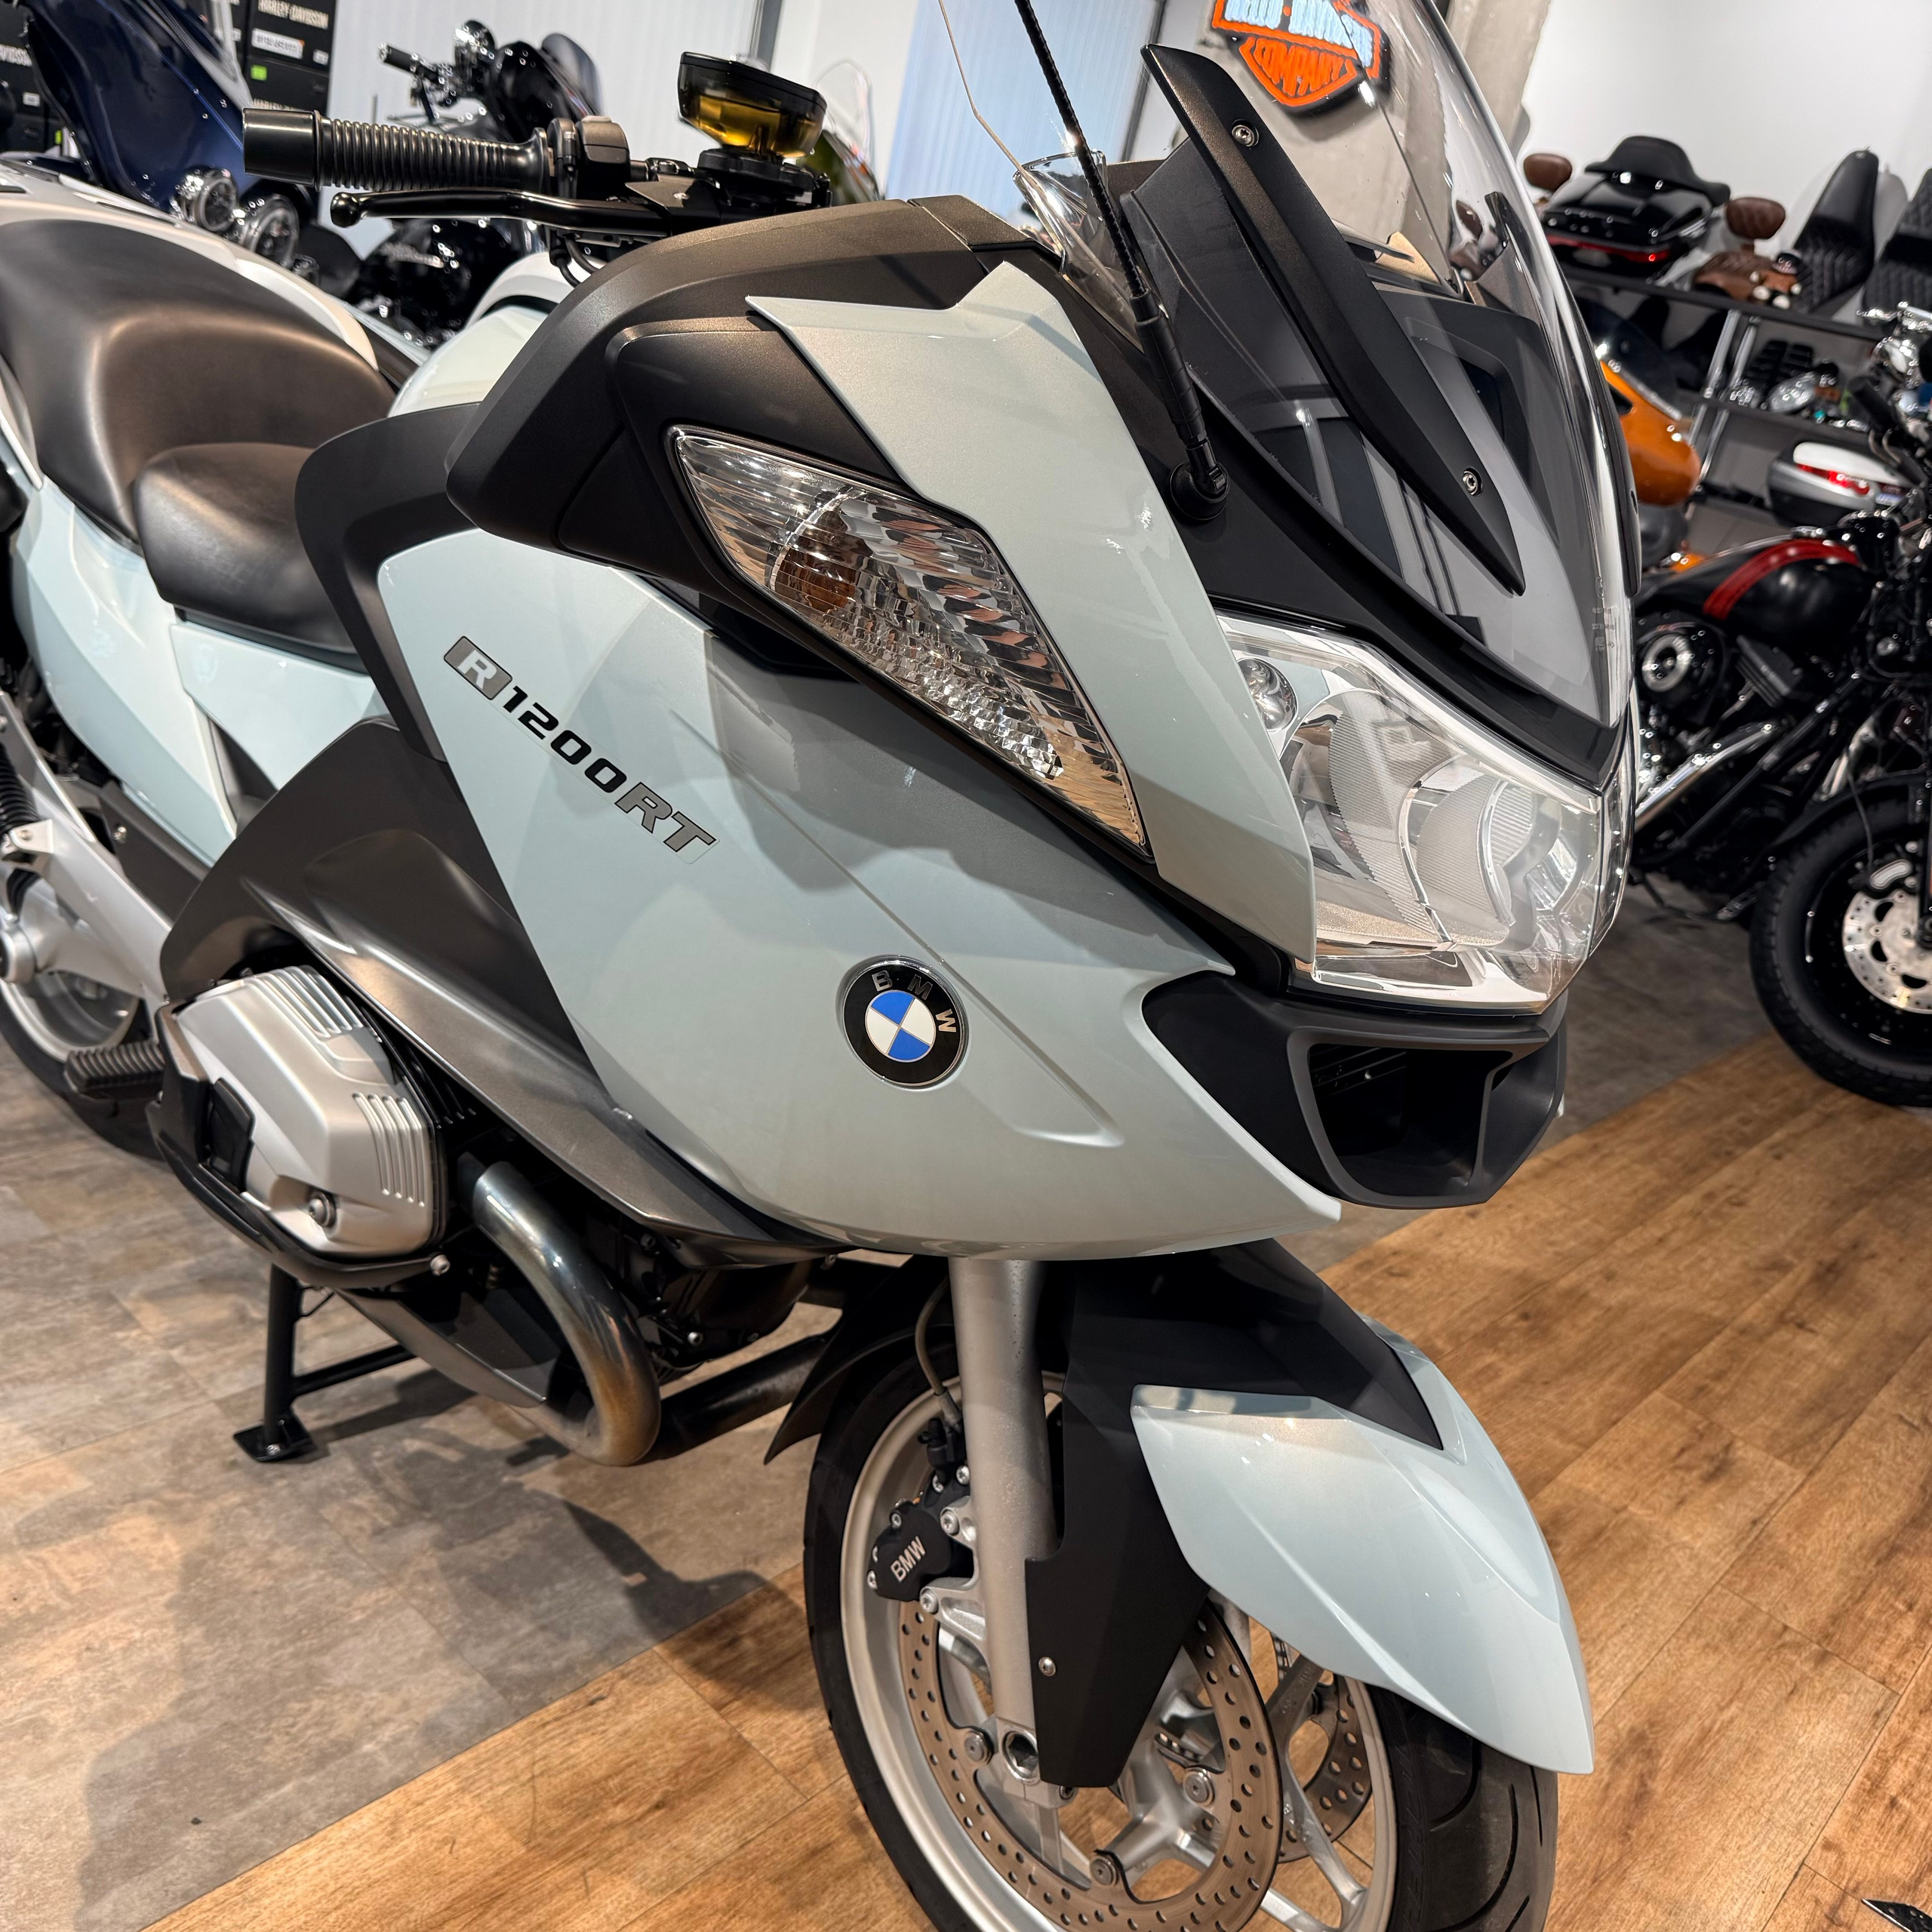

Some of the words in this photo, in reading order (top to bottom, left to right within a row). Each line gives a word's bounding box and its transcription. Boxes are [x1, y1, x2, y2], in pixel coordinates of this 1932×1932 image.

[1254, 38, 1344, 96] COMPANY
[872, 970, 956, 1033] BMW
[891, 1536, 926, 1583] BMW
